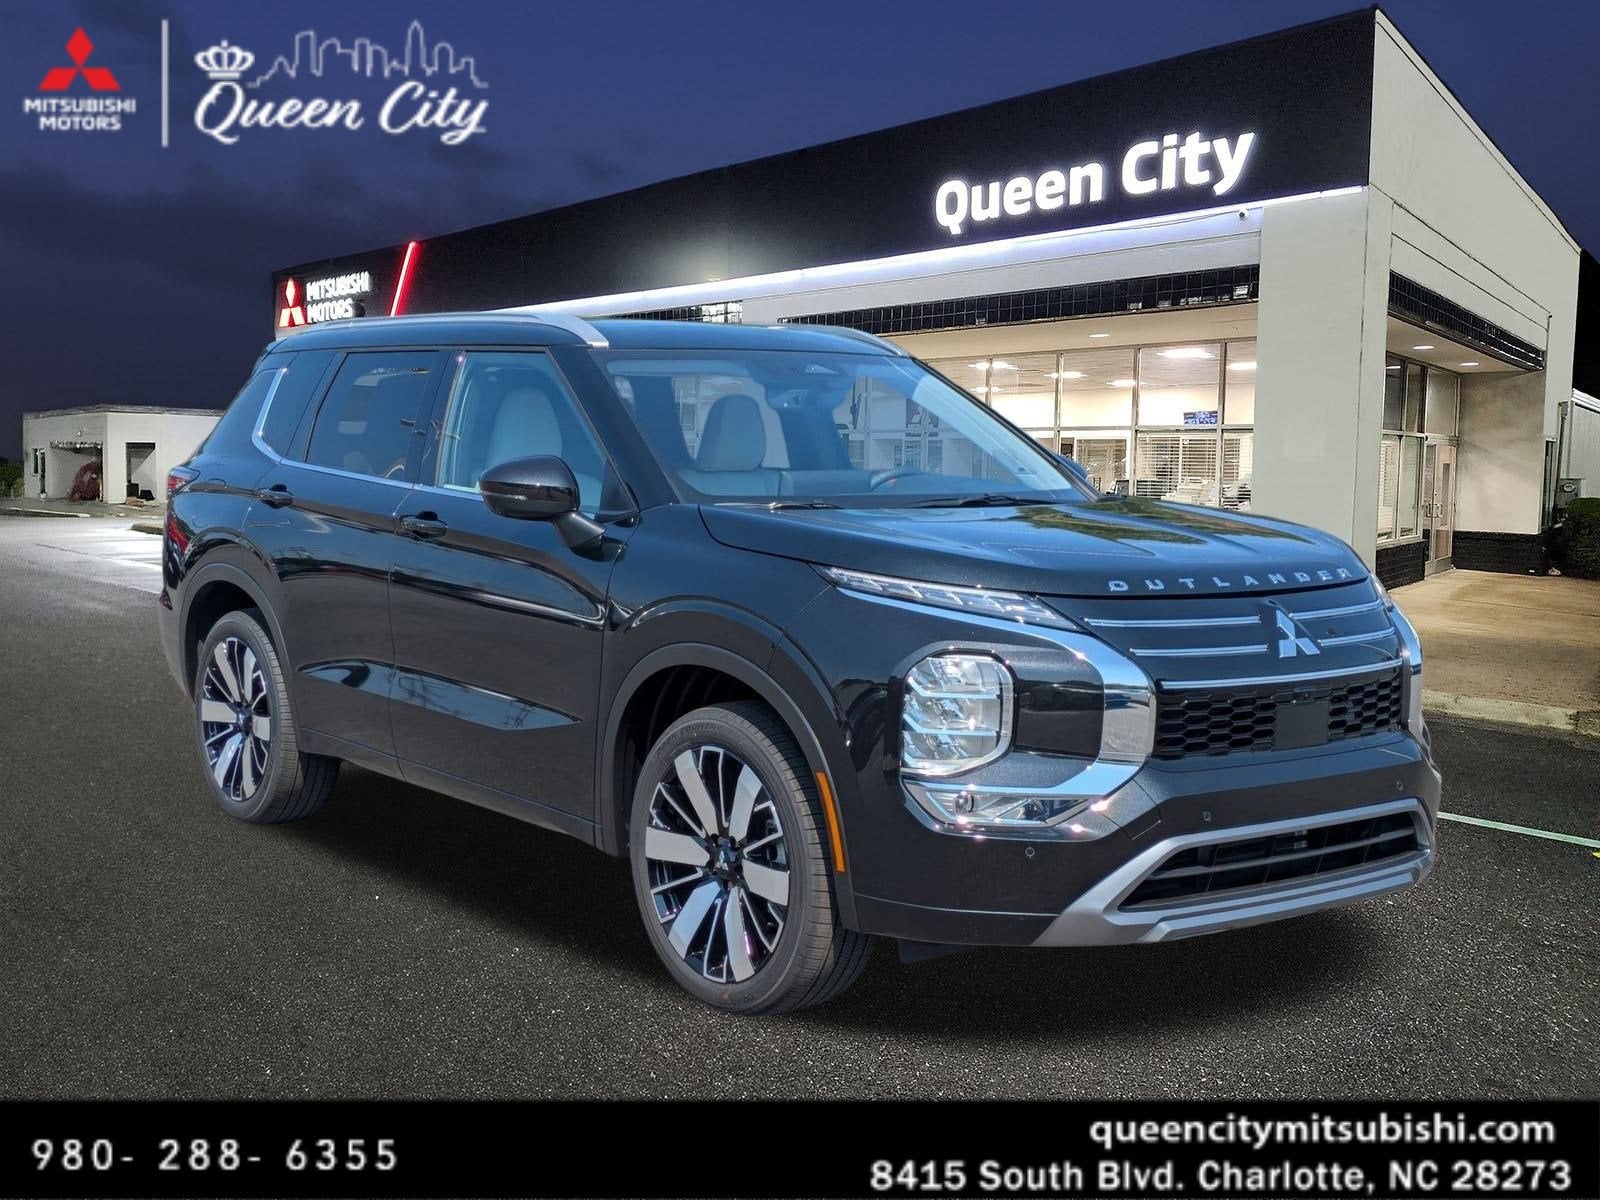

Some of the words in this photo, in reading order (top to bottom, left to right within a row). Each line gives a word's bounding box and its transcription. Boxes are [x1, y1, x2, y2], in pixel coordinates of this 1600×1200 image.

[936, 161, 1103, 234] Queen
[1121, 131, 1255, 195] City
[306, 271, 371, 301] MITSUBISHI
[307, 297, 355, 323] MOTORS
[1108, 567, 1353, 593] OUTLANDER
